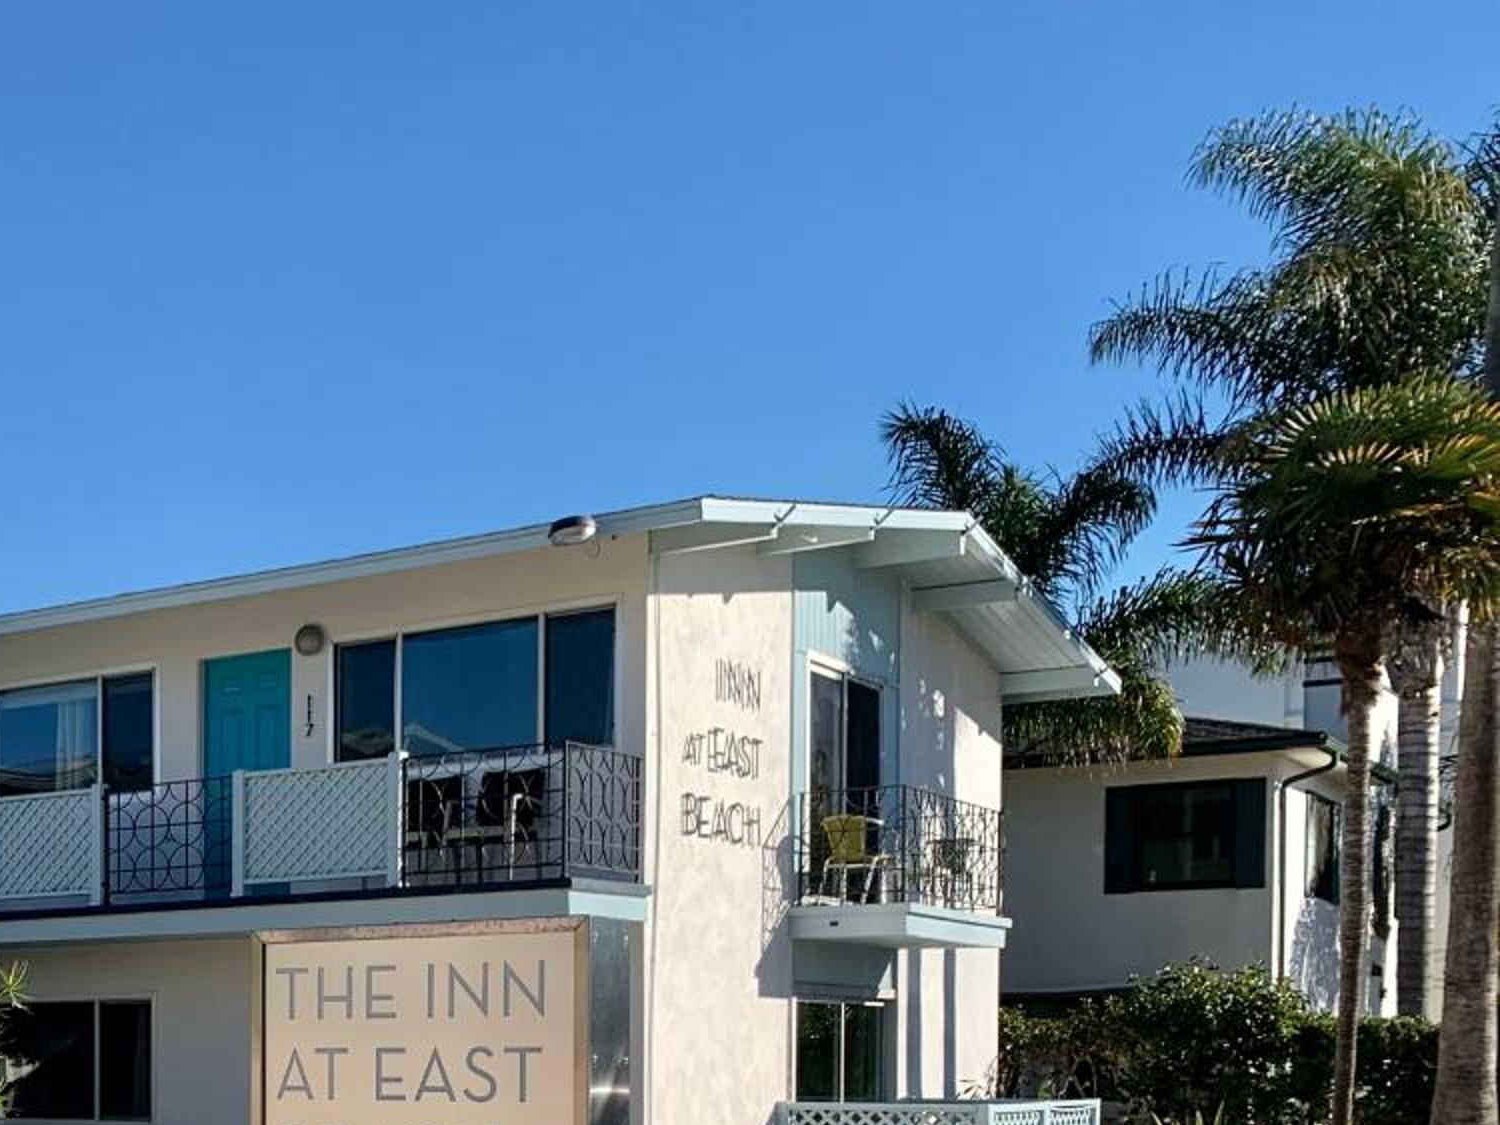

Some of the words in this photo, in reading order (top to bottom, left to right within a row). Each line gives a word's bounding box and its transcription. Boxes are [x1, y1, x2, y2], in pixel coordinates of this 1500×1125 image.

[715, 657, 761, 712] INN
[681, 729, 706, 766] AT
[707, 726, 764, 780] EAST
[680, 791, 762, 848] BEACH
[276, 965, 397, 1020] THE
[427, 959, 546, 1019] INN
[277, 1047, 349, 1101] AT
[375, 1046, 543, 1103] EAST
